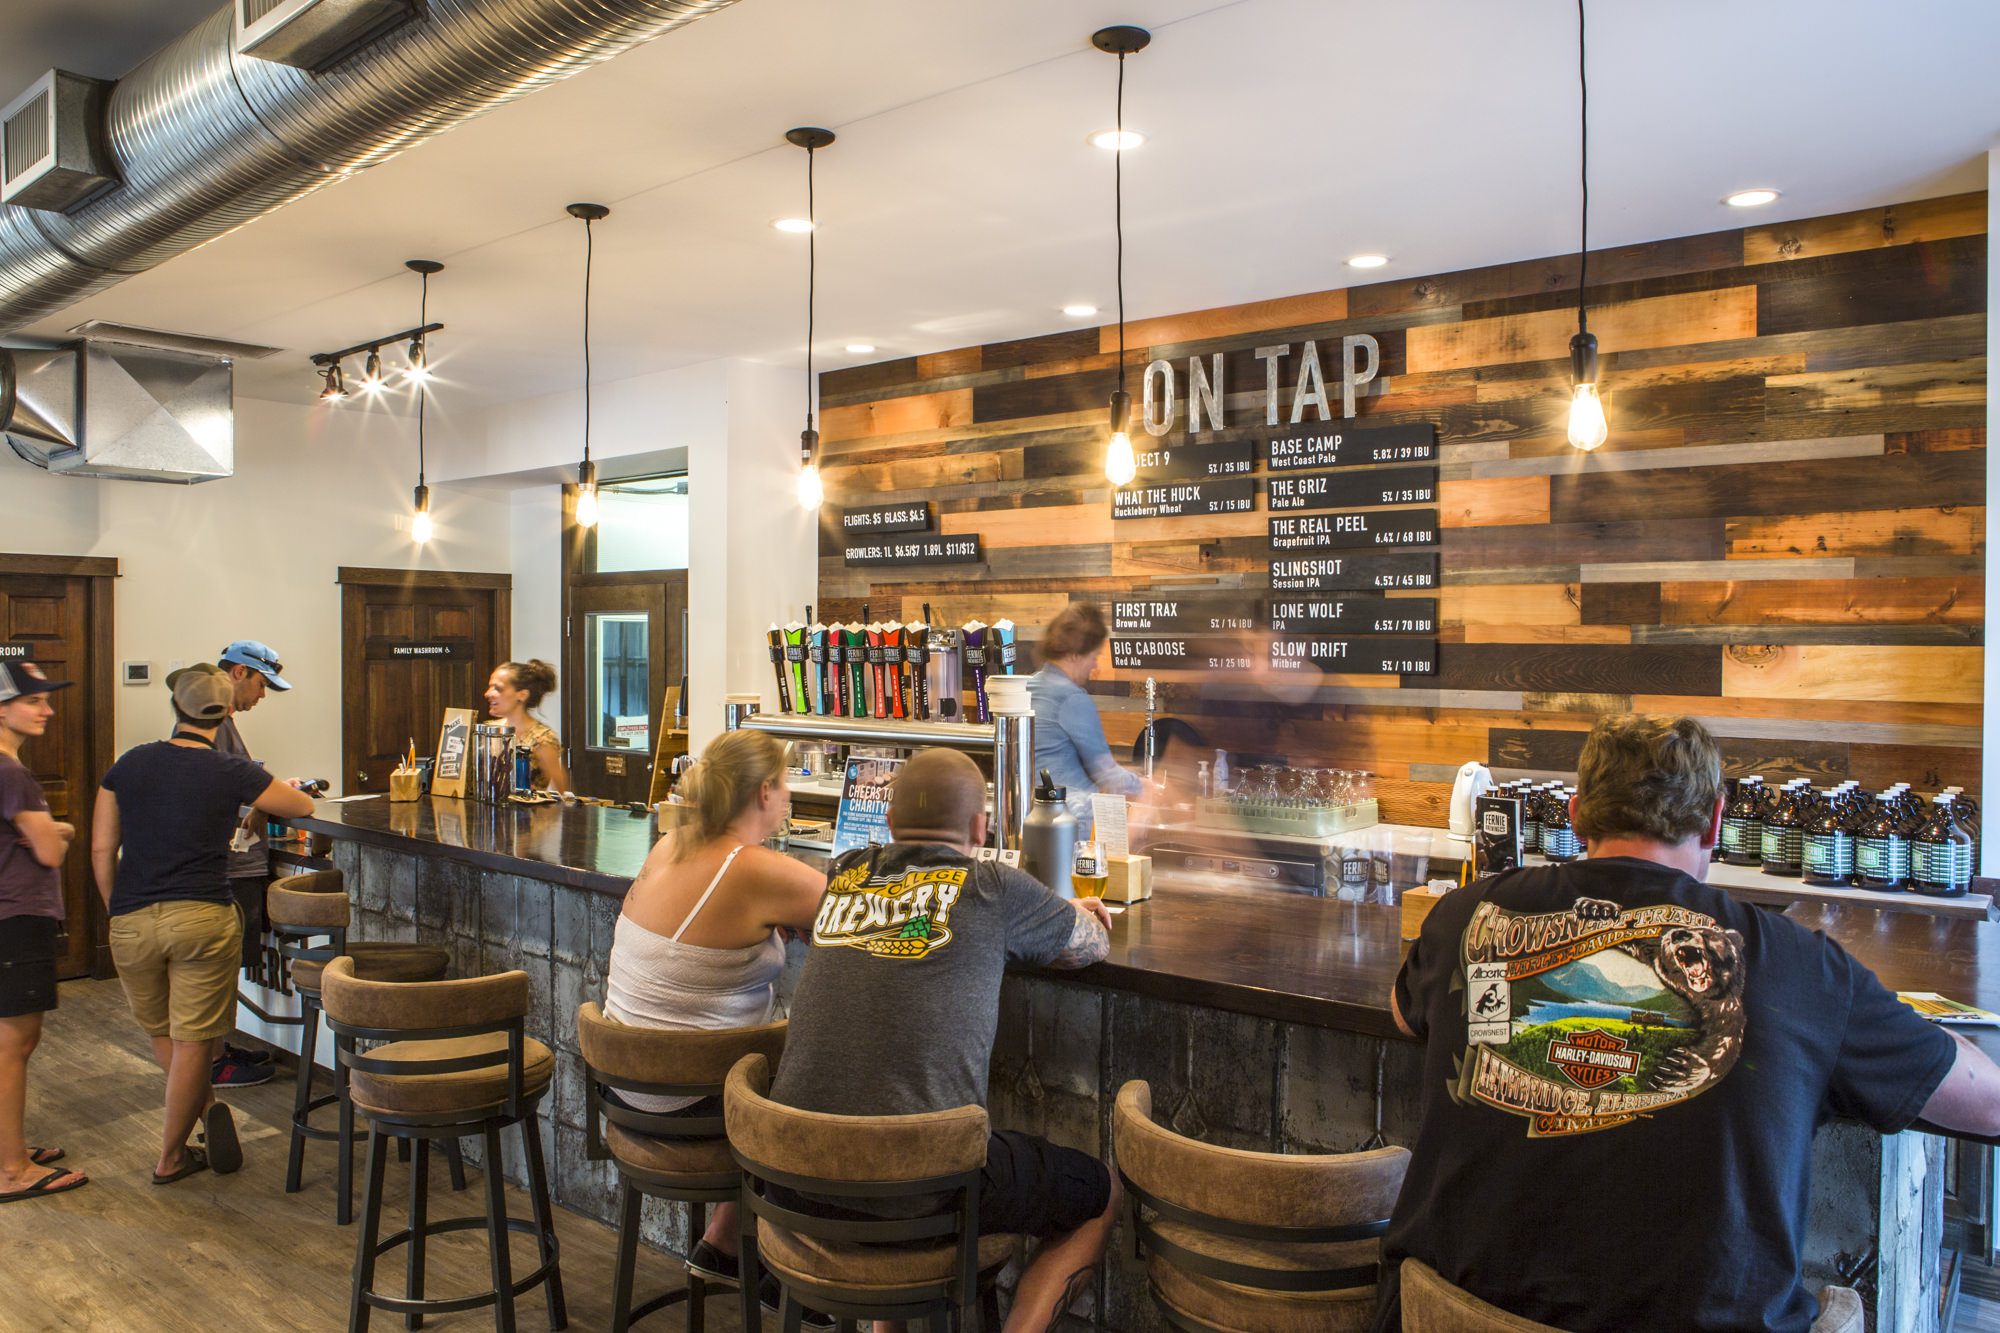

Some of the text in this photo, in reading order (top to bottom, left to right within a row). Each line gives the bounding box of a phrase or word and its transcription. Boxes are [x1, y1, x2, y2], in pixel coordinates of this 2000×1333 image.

[1143, 333, 1380, 437] ON TAP
[1271, 435, 1342, 456] BASE CAMP
[1163, 451, 1170, 466] 9
[1272, 453, 1336, 467] West Coast Pale
[1373, 446, 1430, 460] 5.8% / 39 IBU
[1208, 461, 1250, 474] 5% / 35 IBU
[1271, 478, 1327, 496] THE GRIZ
[1114, 486, 1200, 506] WHAT THE HUCK
[1272, 497, 1304, 508] Pale Ale
[1382, 489, 1430, 502] 5% / 35 IBU
[1114, 504, 1182, 518] Huckleberry Wheat
[1209, 500, 1250, 512] 5% / 15 IBU
[844, 509, 924, 526] FLIGHTS: $5 GLASS: $4.5
[1272, 516, 1368, 536] THE REAL PEEL
[1273, 534, 1330, 548] Grapefruit IPA
[1375, 531, 1432, 544] 6.4% / 68 IBU
[846, 542, 975, 560] GROWLERS: 1L $6.5/$7 1.89L $11/$12
[1272, 560, 1342, 576] SLINGSHOT
[1272, 578, 1320, 588] Session IPA
[1374, 574, 1432, 586] 4.5% / 45 IBU
[1116, 602, 1178, 617] FIRST TRAX
[1273, 602, 1344, 618] LONE WOLF
[1116, 619, 1151, 628] Brown Ale
[1210, 619, 1220, 628] 5%
[1228, 619, 1236, 628] 14
[1239, 618, 1252, 628] IBU
[1272, 620, 1286, 630] IPA
[1374, 620, 1430, 630] 6.5% / 70 IBU
[414, 646, 442, 654] WASHROOM
[966, 650, 983, 658] FERNIE
[1114, 642, 1186, 656] BIG CABOOSE
[1272, 642, 1348, 658] SLOW DRIFT
[1116, 657, 1141, 666] Red Ale
[1209, 658, 1218, 668] 5%
[1225, 658, 1235, 668] 25
[1238, 658, 1250, 668] IBU
[1272, 658, 1301, 669] Witbier
[1382, 660, 1430, 672] 5% / 10 IBU
[848, 784, 894, 802] CHEERS TO
[849, 798, 888, 814] CHARITY!
[1486, 814, 1506, 826] FERNIE
[1078, 860, 1095, 869] FERNIE
[816, 883, 959, 934] BREWERY
[1634, 904, 1717, 929] TRAIL
[1506, 926, 1661, 978] HARLEY-DAVIDSON
[1470, 966, 1508, 980] Alberta
[1484, 990, 1498, 1008] 3
[1470, 1028, 1507, 1038] CROWSNEST
[1576, 1036, 1618, 1050] MOTOR
[1555, 1048, 1632, 1069] HARLEY-DAVIDSON
[1476, 1048, 1688, 1116] LETHBRIDGE, ALBERTA
[1570, 1066, 1610, 1084] CYCLES
[1536, 1114, 1632, 1135] CANADA
